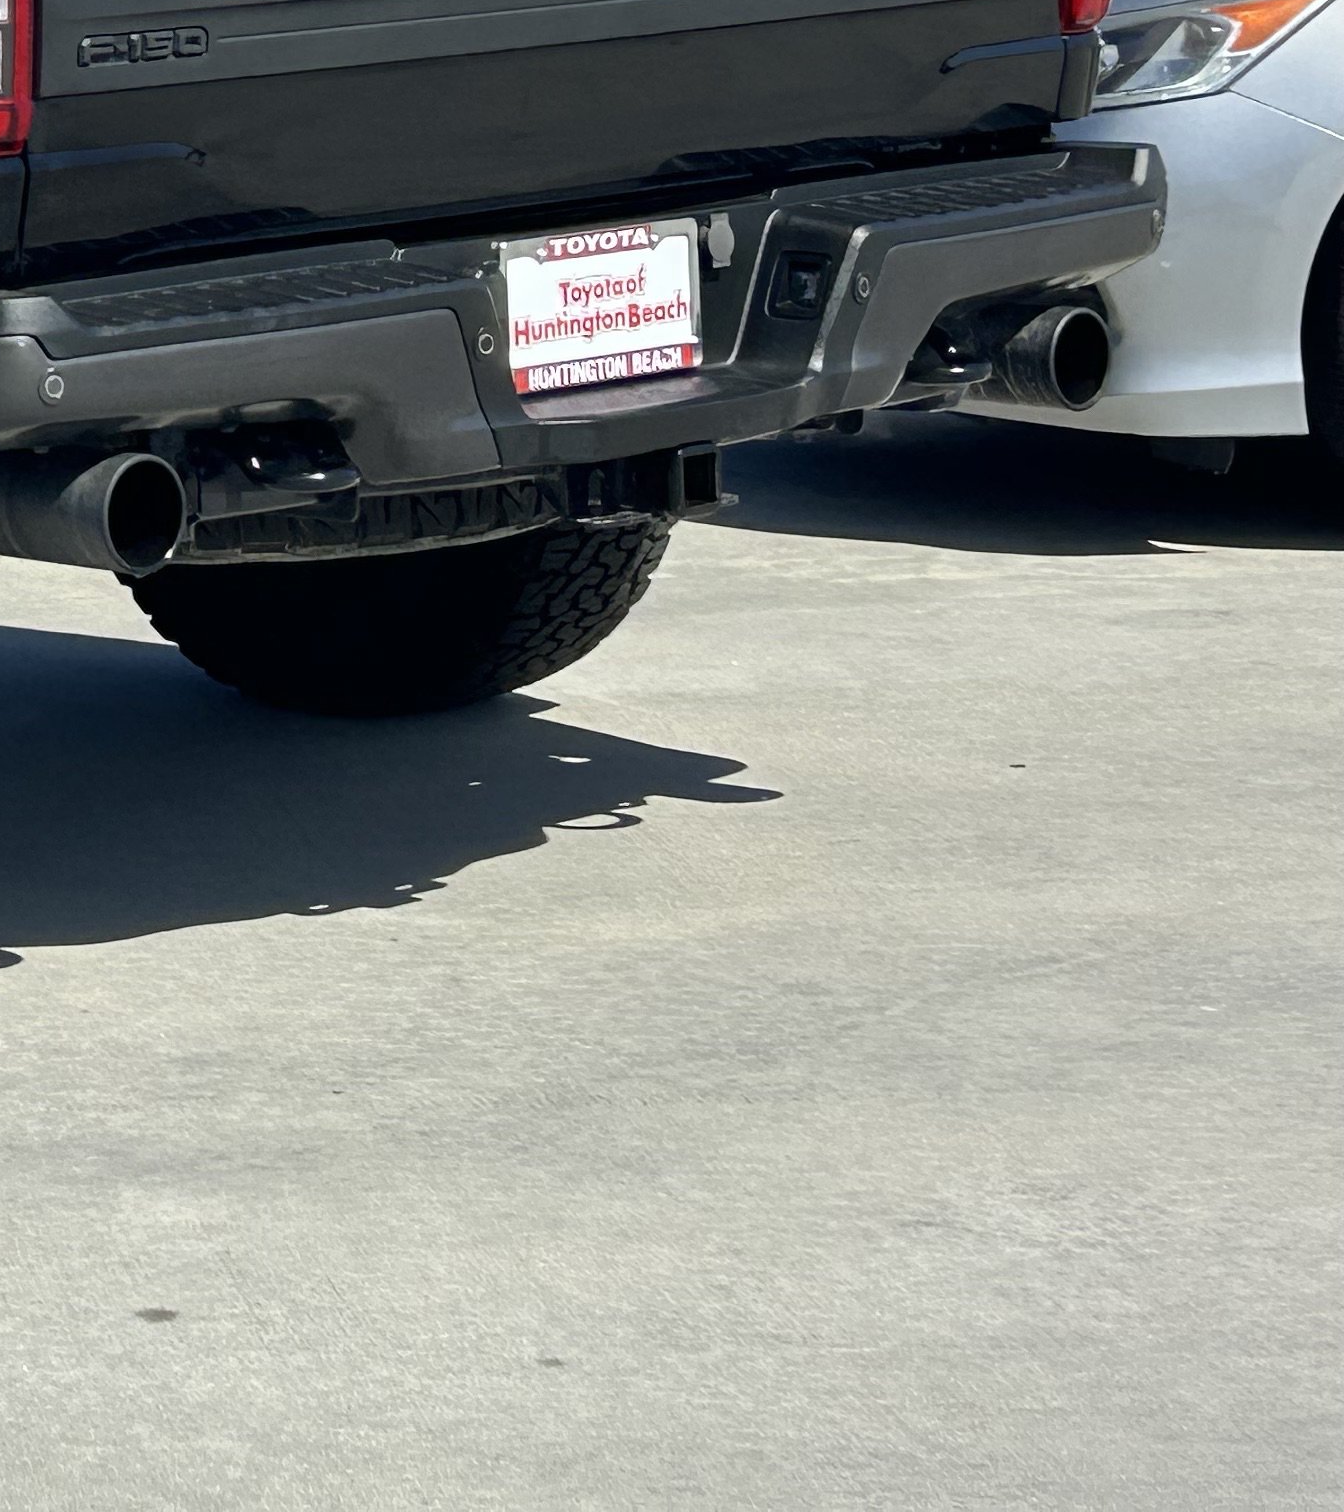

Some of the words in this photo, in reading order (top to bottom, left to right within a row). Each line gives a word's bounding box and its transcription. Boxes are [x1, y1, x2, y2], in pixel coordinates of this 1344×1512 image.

[77, 26, 209, 67] F-150
[548, 227, 650, 257] TOYOTA
[558, 278, 623, 308] Toyota
[625, 263, 648, 294] of
[514, 310, 626, 346] Huntington
[627, 291, 689, 328] Beach
[528, 354, 627, 391] HUNTINGTON
[632, 346, 683, 374] BEACH
